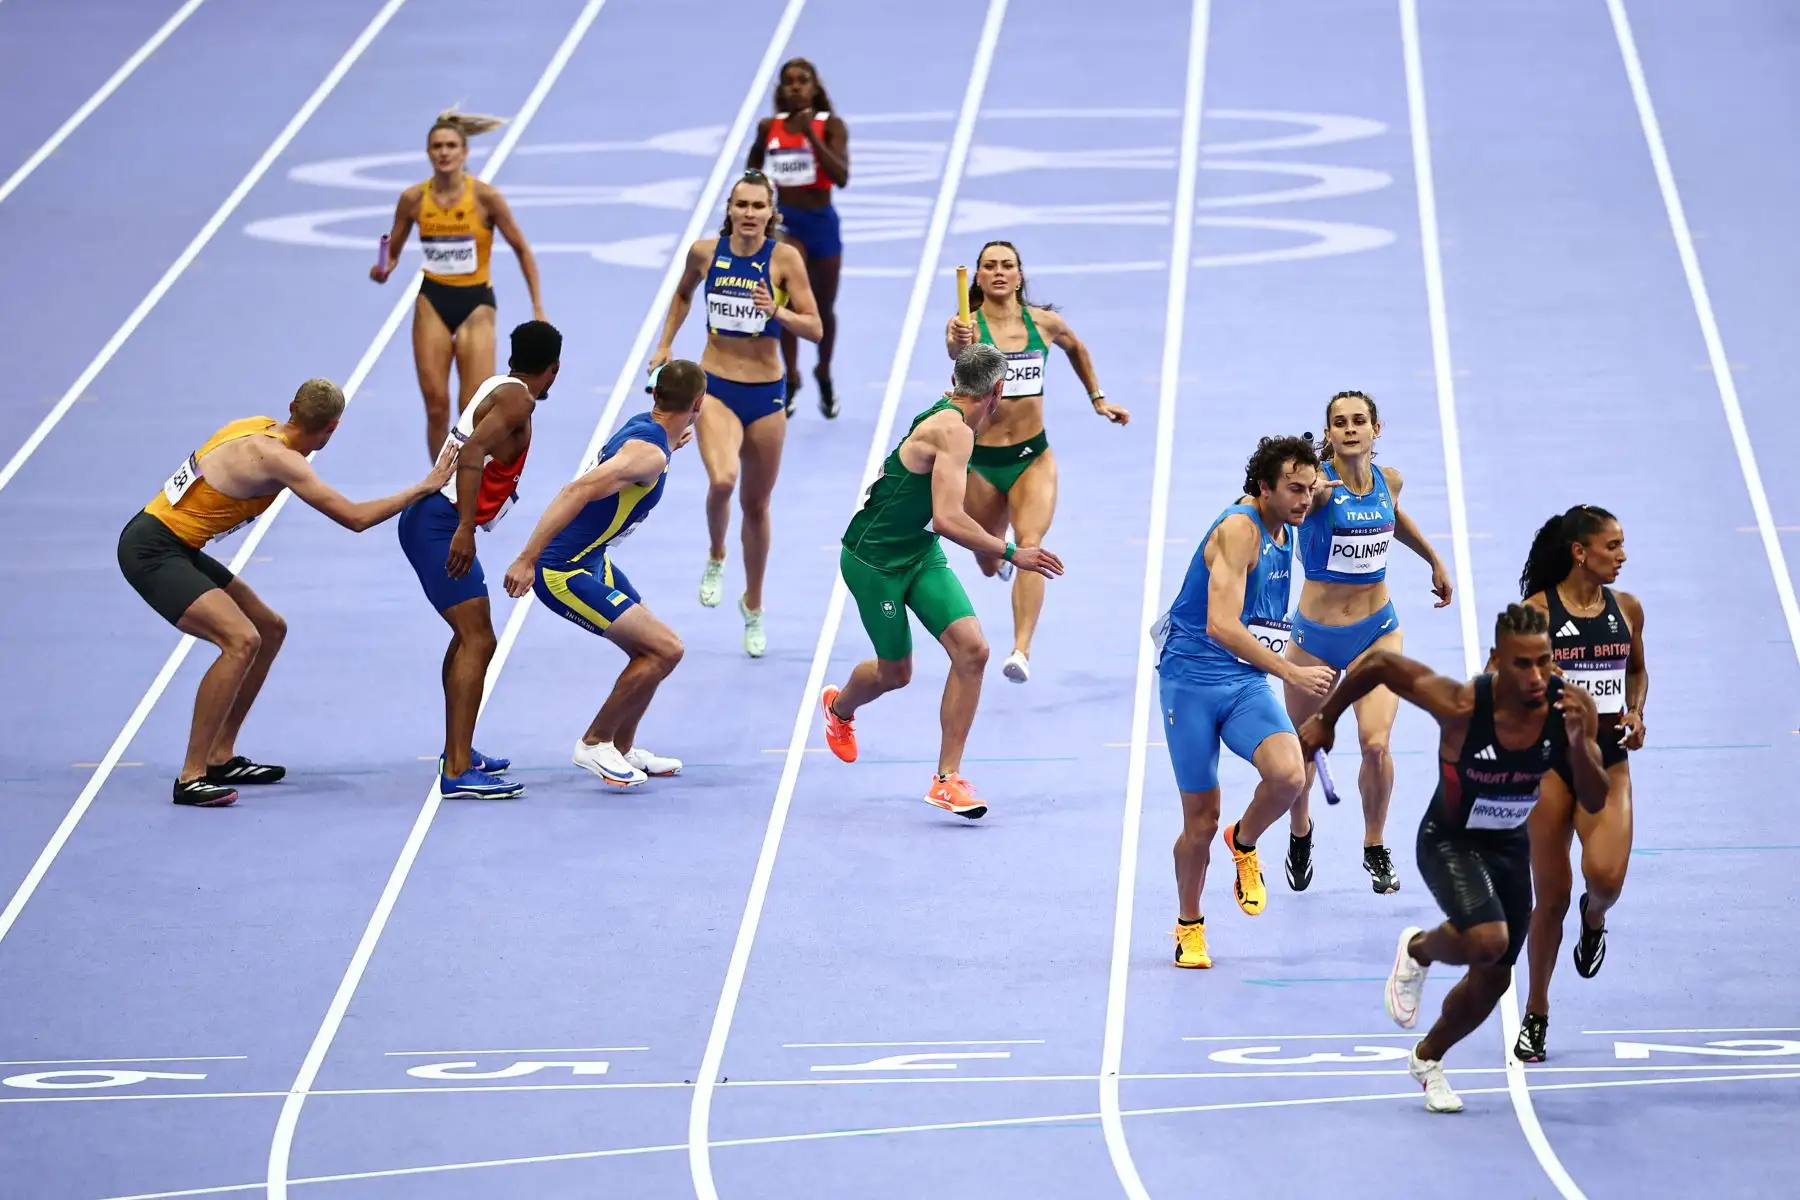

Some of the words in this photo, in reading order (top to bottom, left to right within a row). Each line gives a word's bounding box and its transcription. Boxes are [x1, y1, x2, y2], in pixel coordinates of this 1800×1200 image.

[1347, 510, 1384, 521] ITALIA
[1332, 539, 1390, 559] POLINARI
[1265, 620, 1282, 629] PARIS
[1551, 647, 1586, 660] REAT
